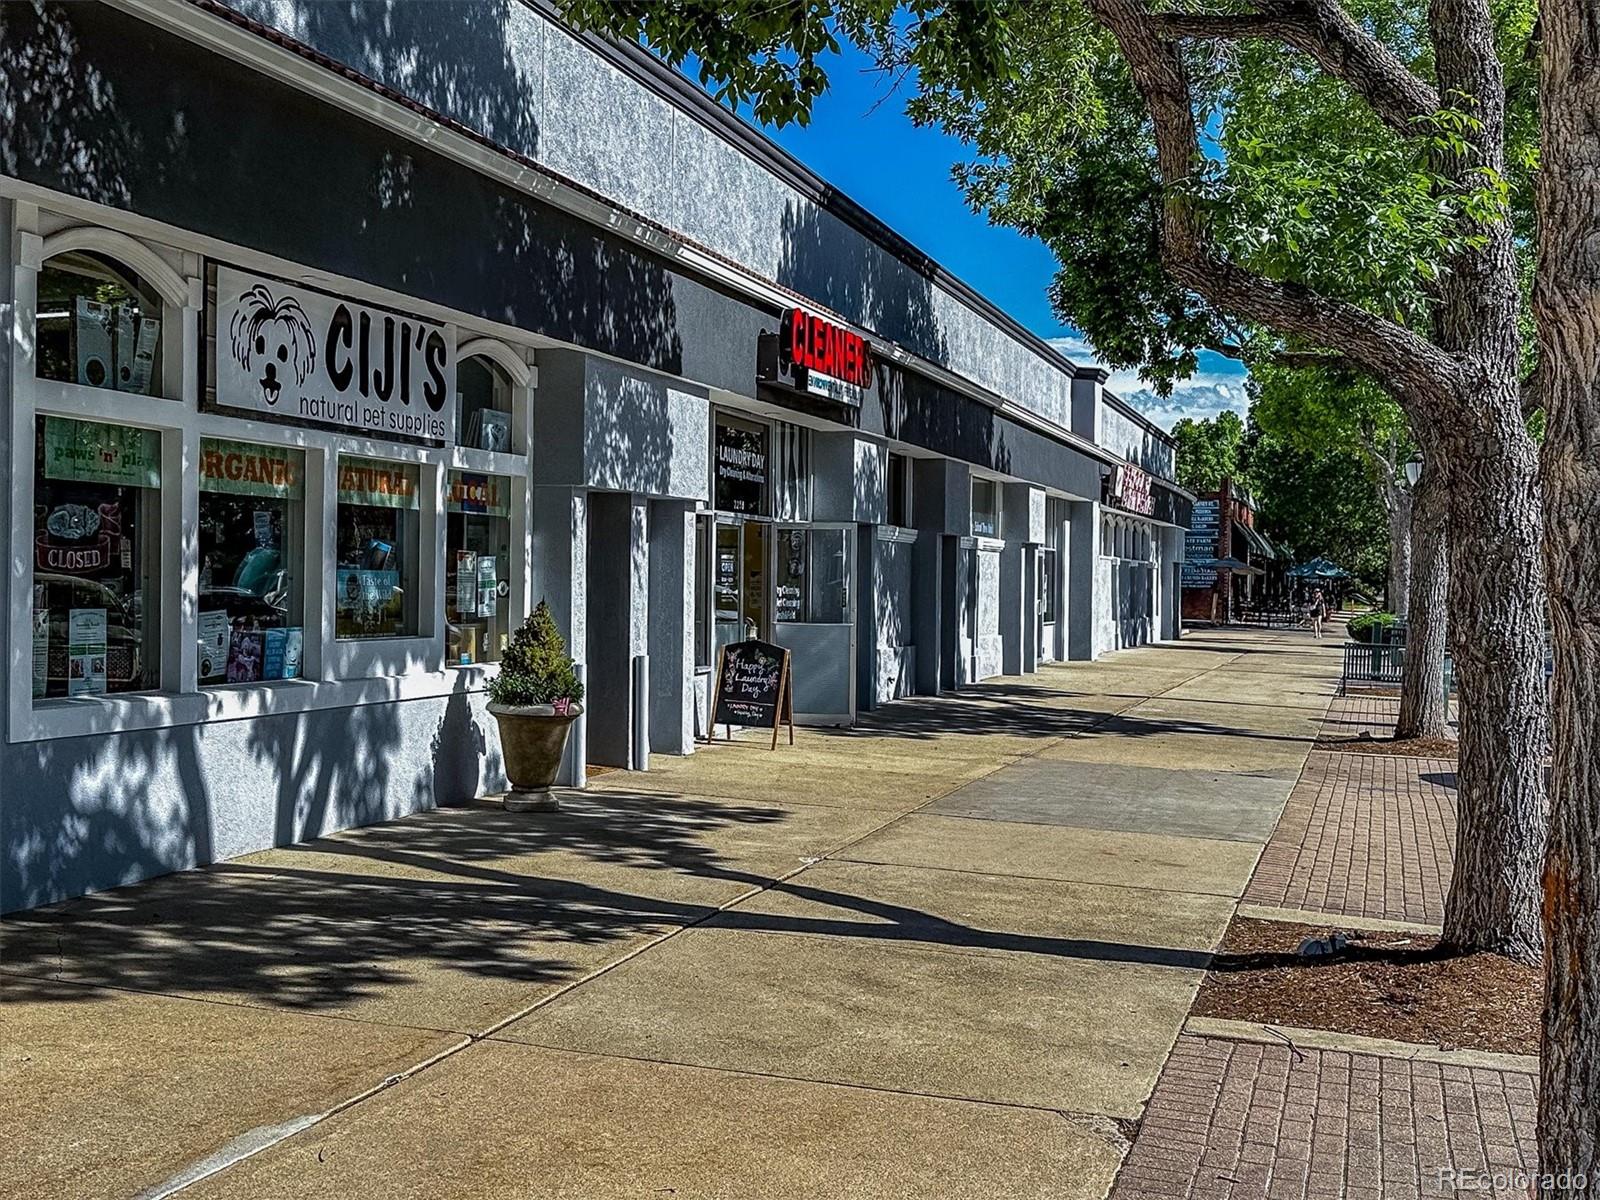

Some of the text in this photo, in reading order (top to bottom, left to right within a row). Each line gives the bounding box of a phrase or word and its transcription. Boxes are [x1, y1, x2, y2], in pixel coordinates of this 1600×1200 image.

[325, 303, 447, 413] CIJI'S
[791, 307, 873, 390] CLEANERS
[299, 395, 446, 437] natural pet supplies
[54, 447, 95, 462] paws
[720, 444, 765, 470] LAUNDRY DAY
[338, 466, 415, 497] ATURAL
[48, 549, 101, 569] CLOSED
[362, 574, 391, 586] Taste of
[735, 658, 766, 675] Happy
[735, 673, 769, 692] Laundry
[741, 682, 761, 699] Day
